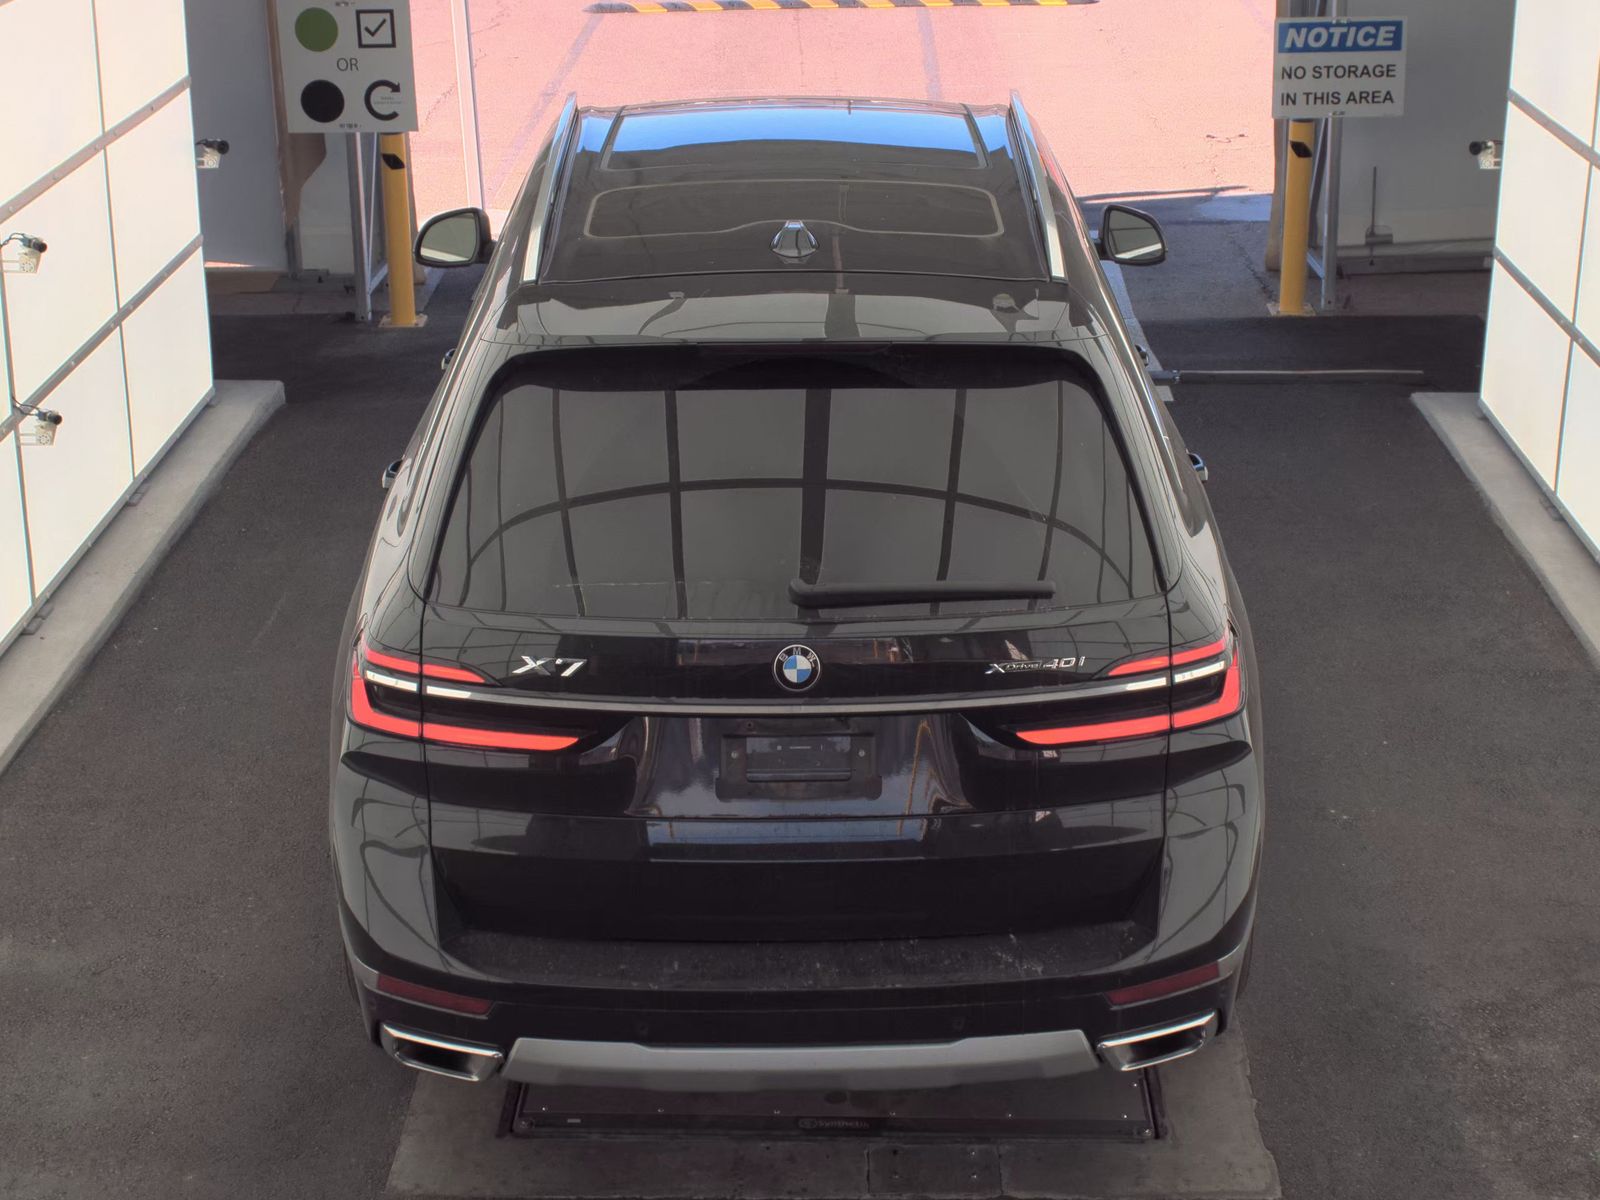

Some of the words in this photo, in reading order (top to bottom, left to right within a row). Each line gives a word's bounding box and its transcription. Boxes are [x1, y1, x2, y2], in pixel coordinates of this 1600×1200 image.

[1284, 26, 1396, 48] NOTICE
[336, 57, 360, 72] OR
[1281, 66, 1306, 80] NO
[1312, 64, 1397, 79] STORAGE
[1280, 92, 1297, 106] IN
[1303, 91, 1341, 106] THIS
[1345, 90, 1394, 105] AREA
[511, 655, 588, 677] X7
